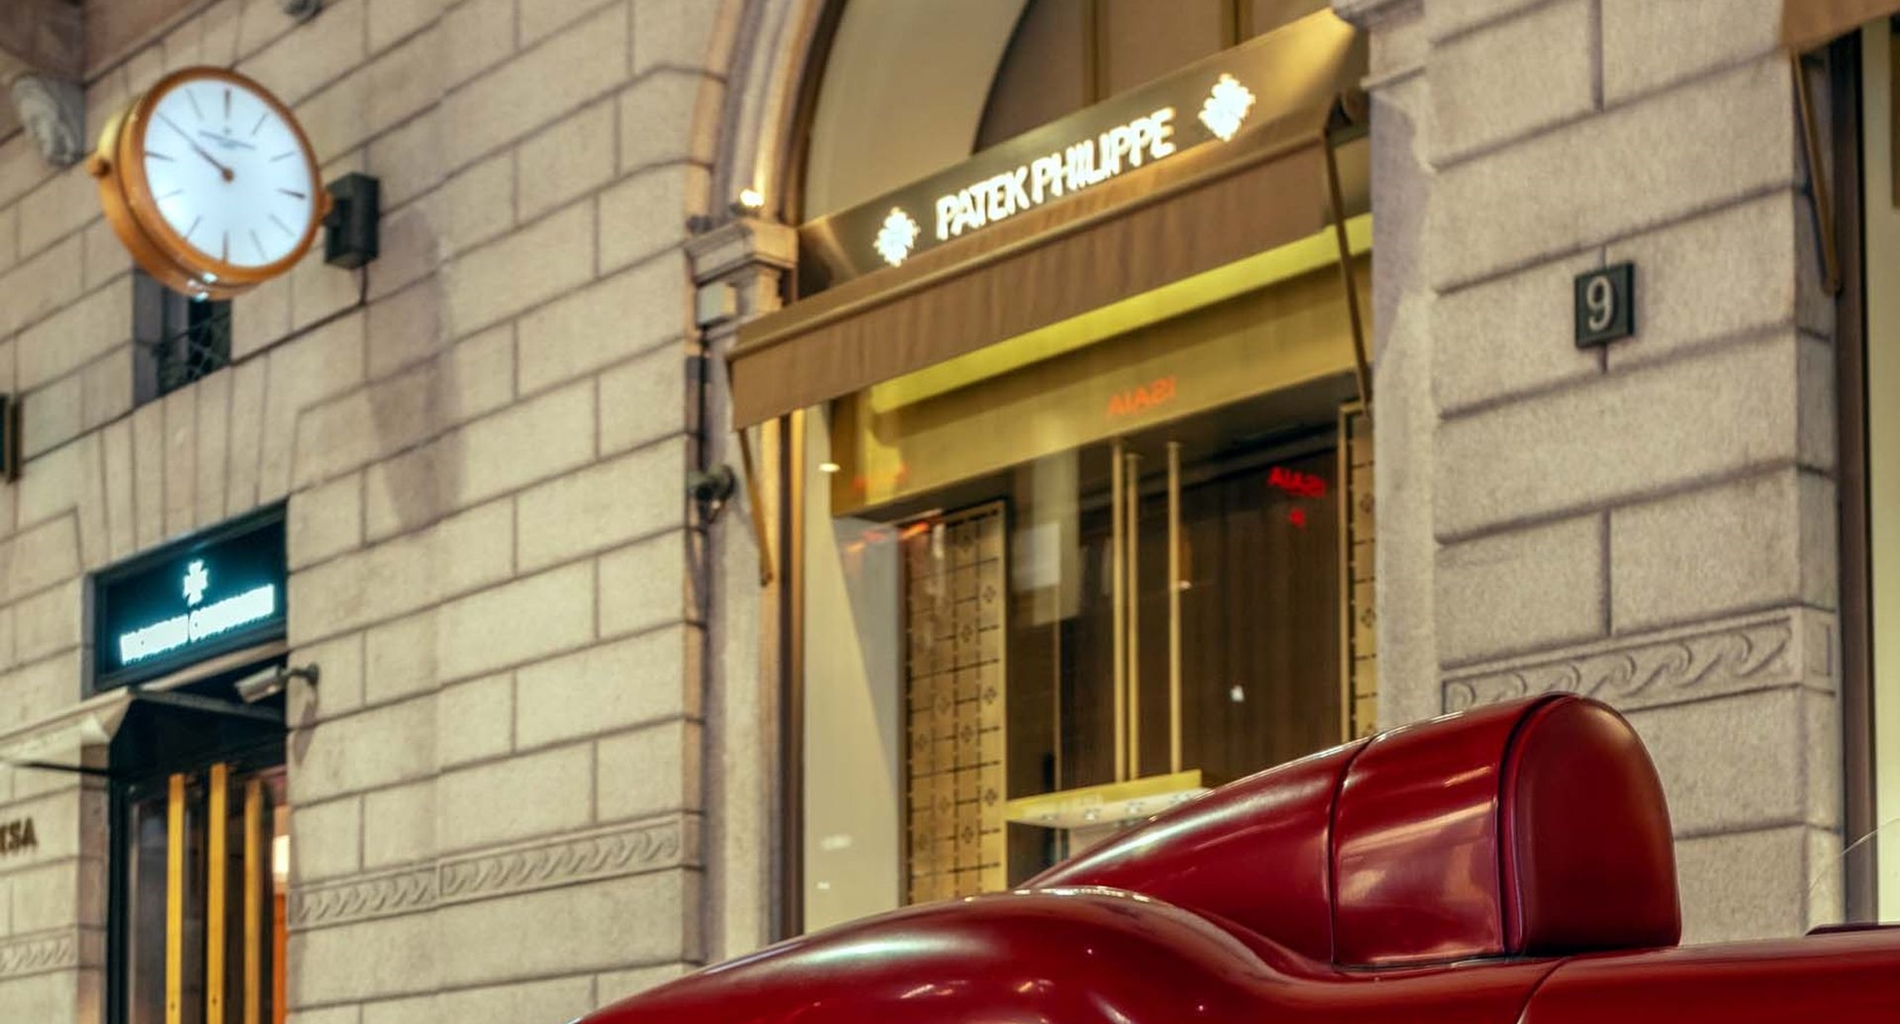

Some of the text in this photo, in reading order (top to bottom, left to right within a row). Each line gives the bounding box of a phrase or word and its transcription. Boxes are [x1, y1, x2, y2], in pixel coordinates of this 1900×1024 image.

[935, 107, 1177, 240] PATEK PHILIPPE
[1586, 275, 1613, 332] 9
